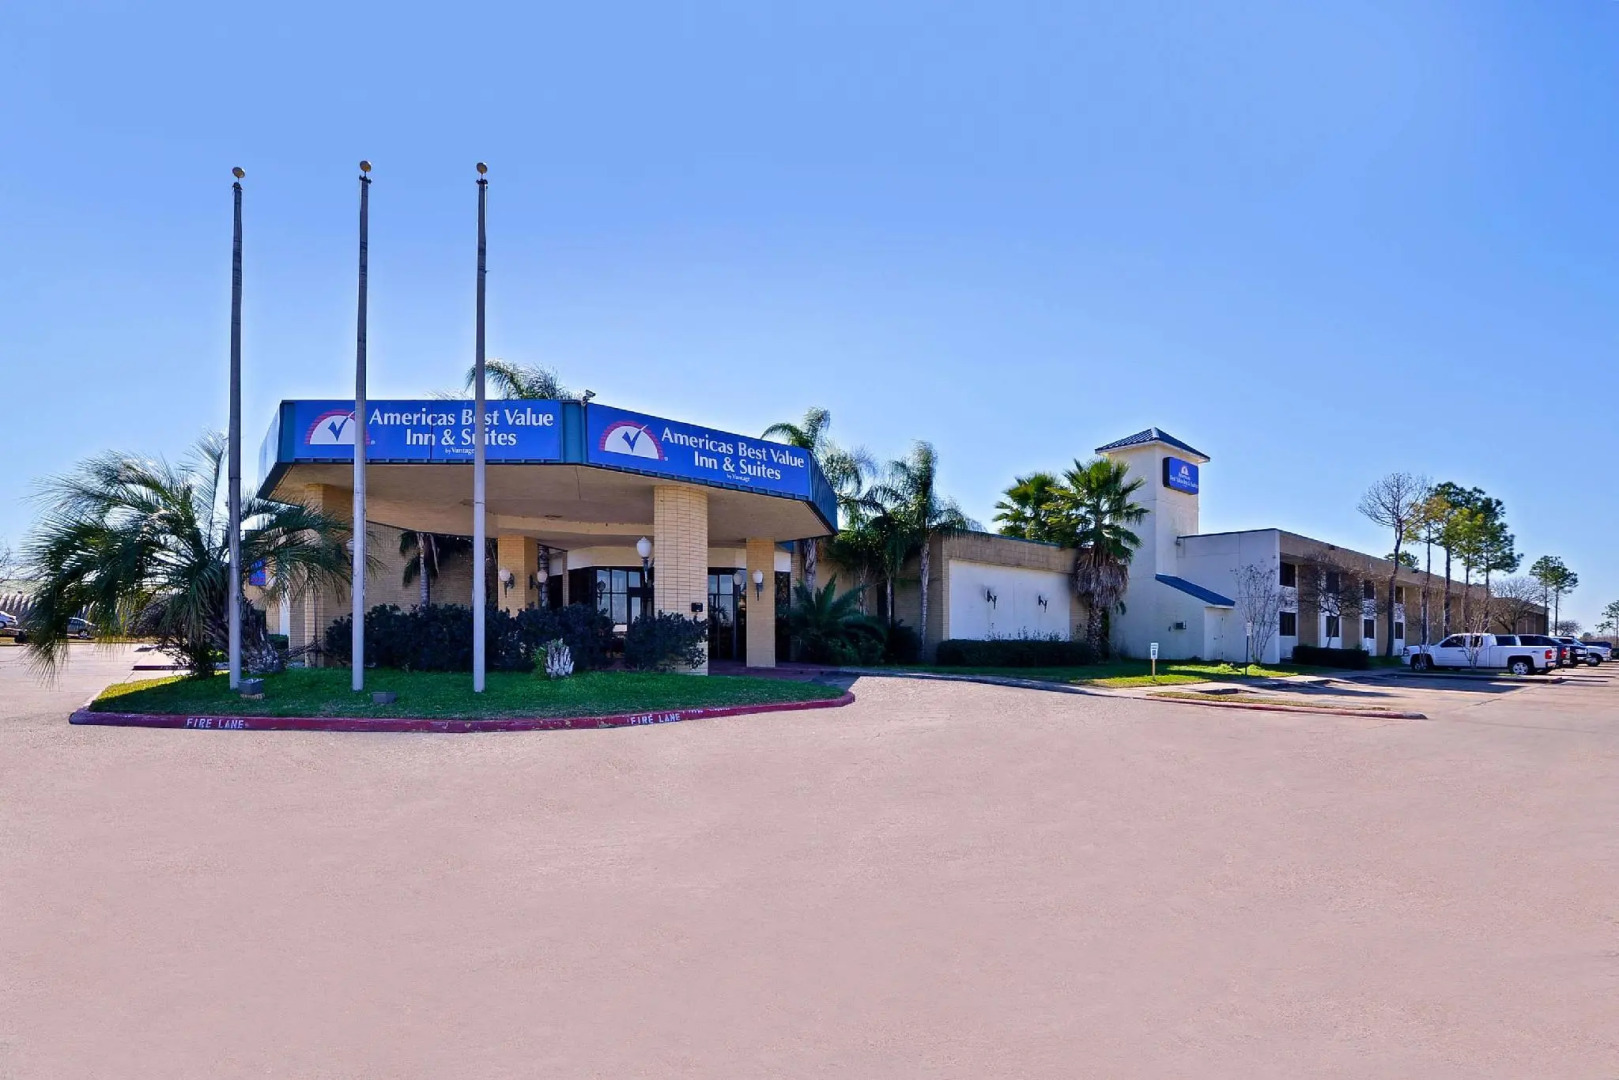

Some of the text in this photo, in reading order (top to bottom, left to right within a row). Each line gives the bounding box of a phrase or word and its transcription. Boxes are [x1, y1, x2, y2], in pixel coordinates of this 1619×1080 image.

[369, 407, 554, 427] Americas Bst Value
[406, 428, 436, 446] Inn
[441, 428, 456, 446] &
[661, 427, 805, 468] Americas Best Value
[694, 451, 781, 480] Inn & Suites
[186, 717, 245, 729] FIRE LANE
[630, 713, 681, 725] FIRE LANE
